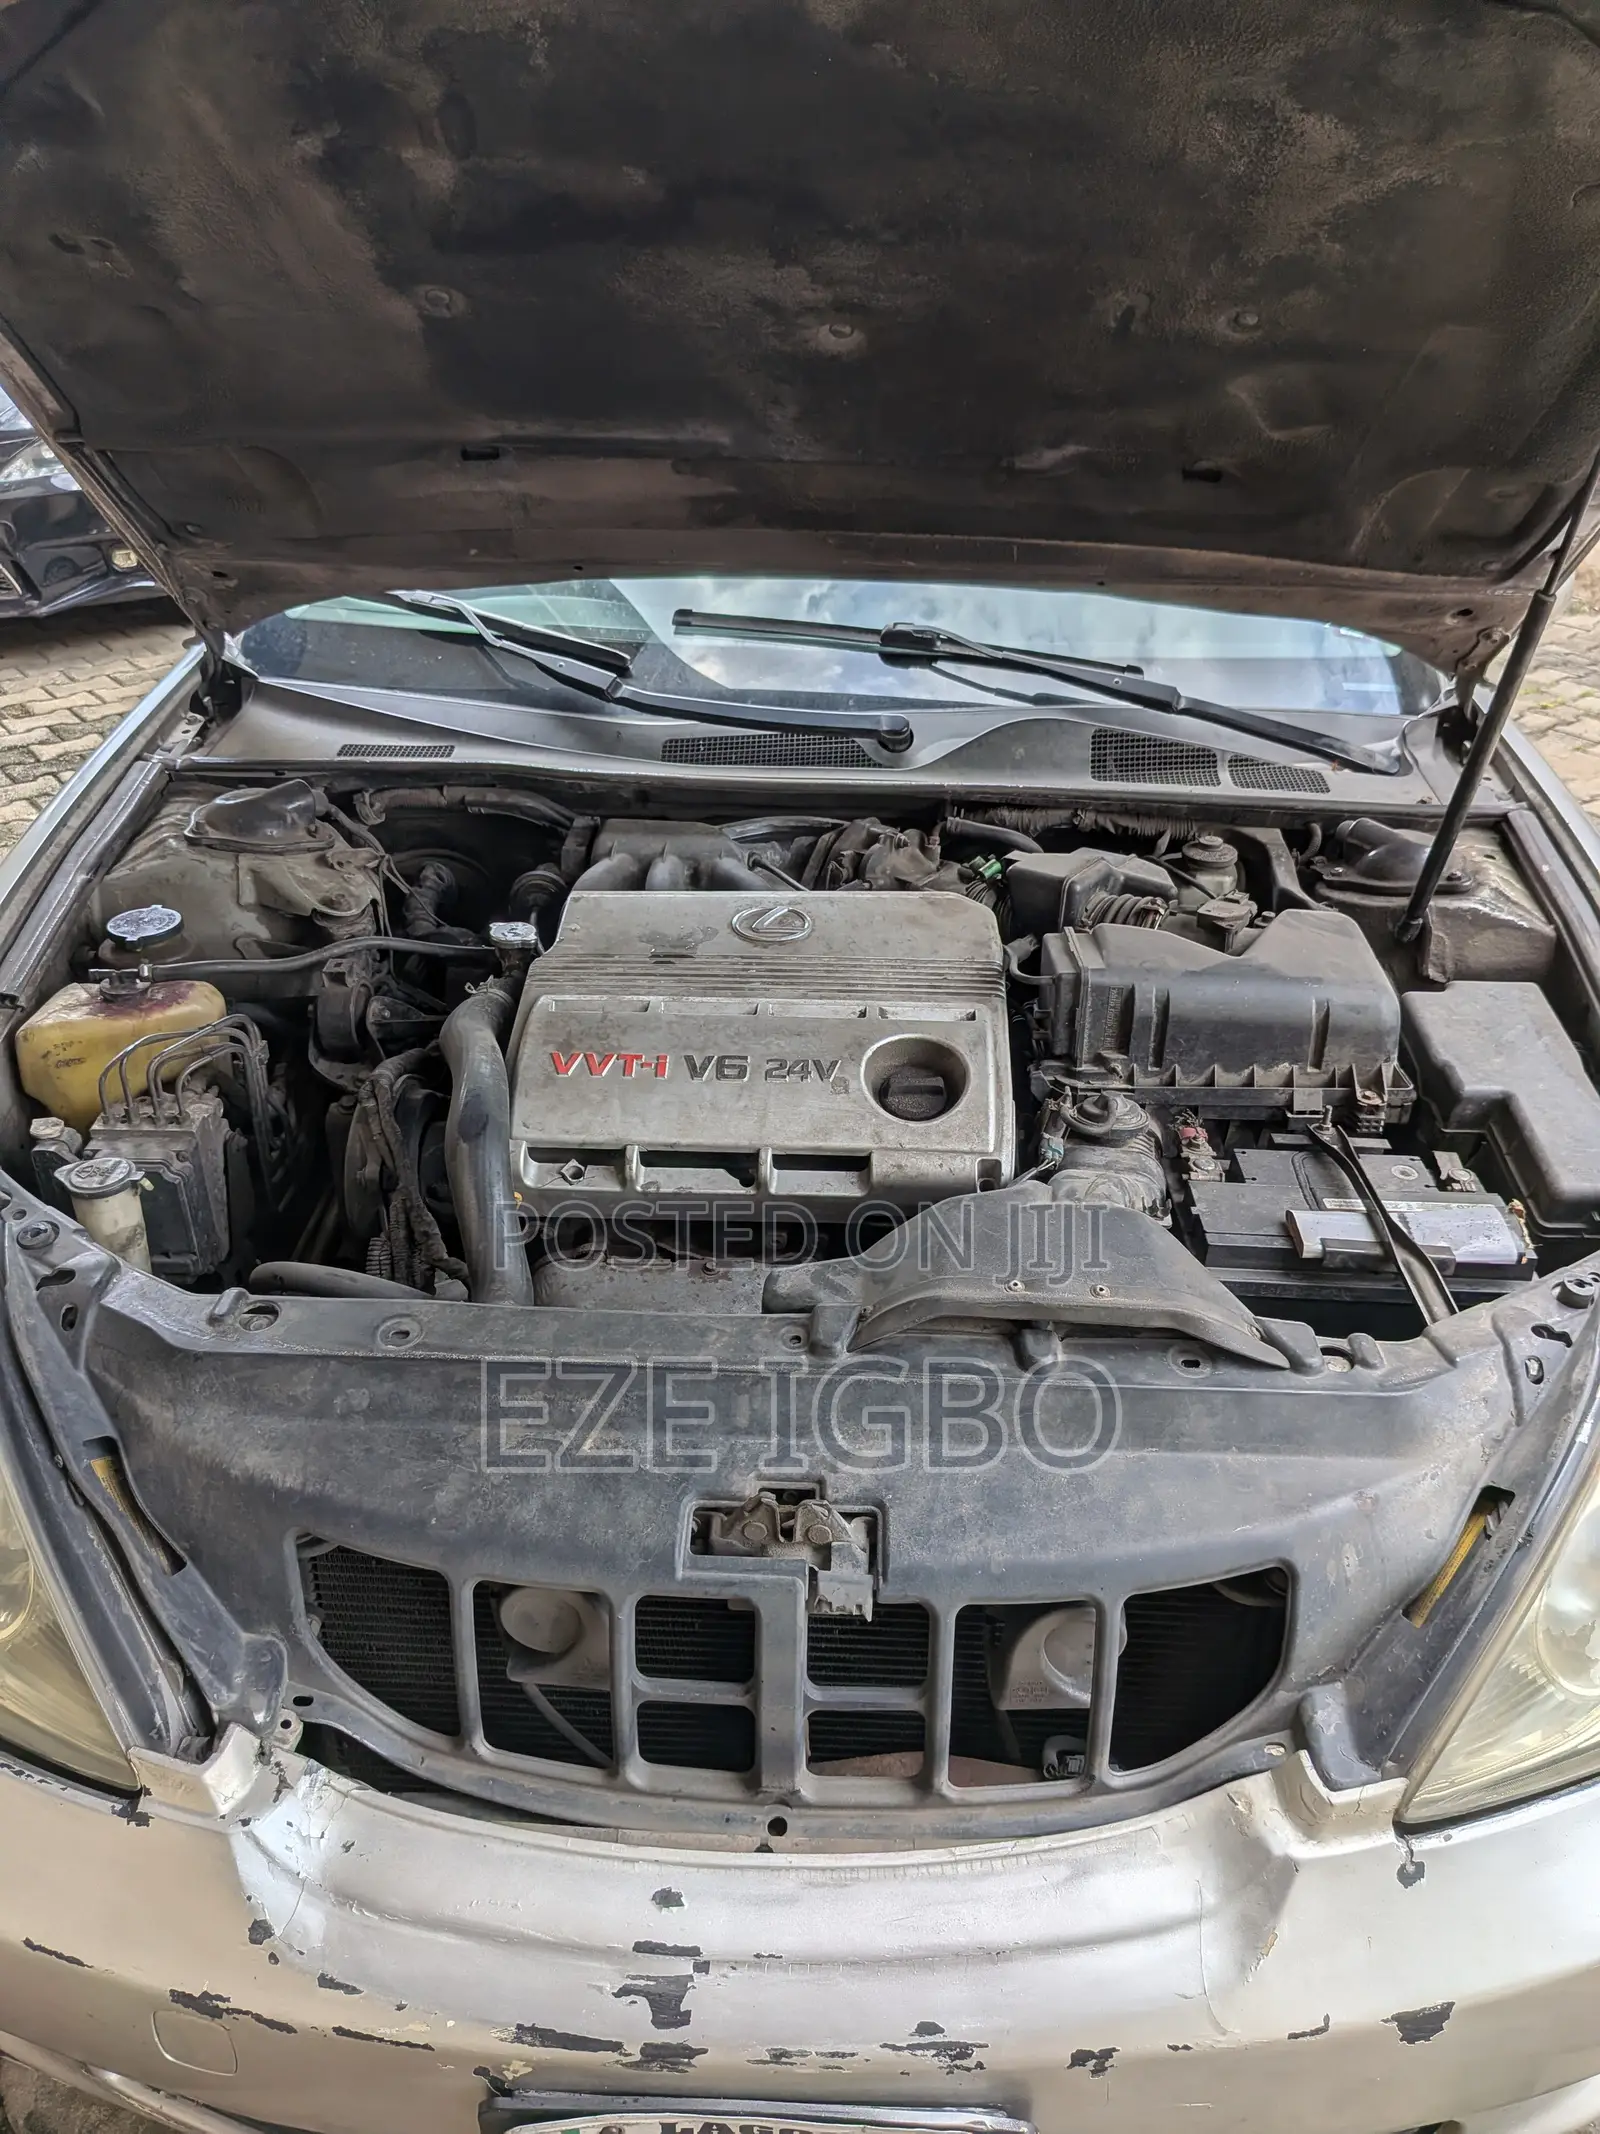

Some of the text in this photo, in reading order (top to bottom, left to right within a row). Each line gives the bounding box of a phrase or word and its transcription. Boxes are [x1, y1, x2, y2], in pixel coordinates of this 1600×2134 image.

[551, 1051, 841, 1082] VVT-i V6 24V
